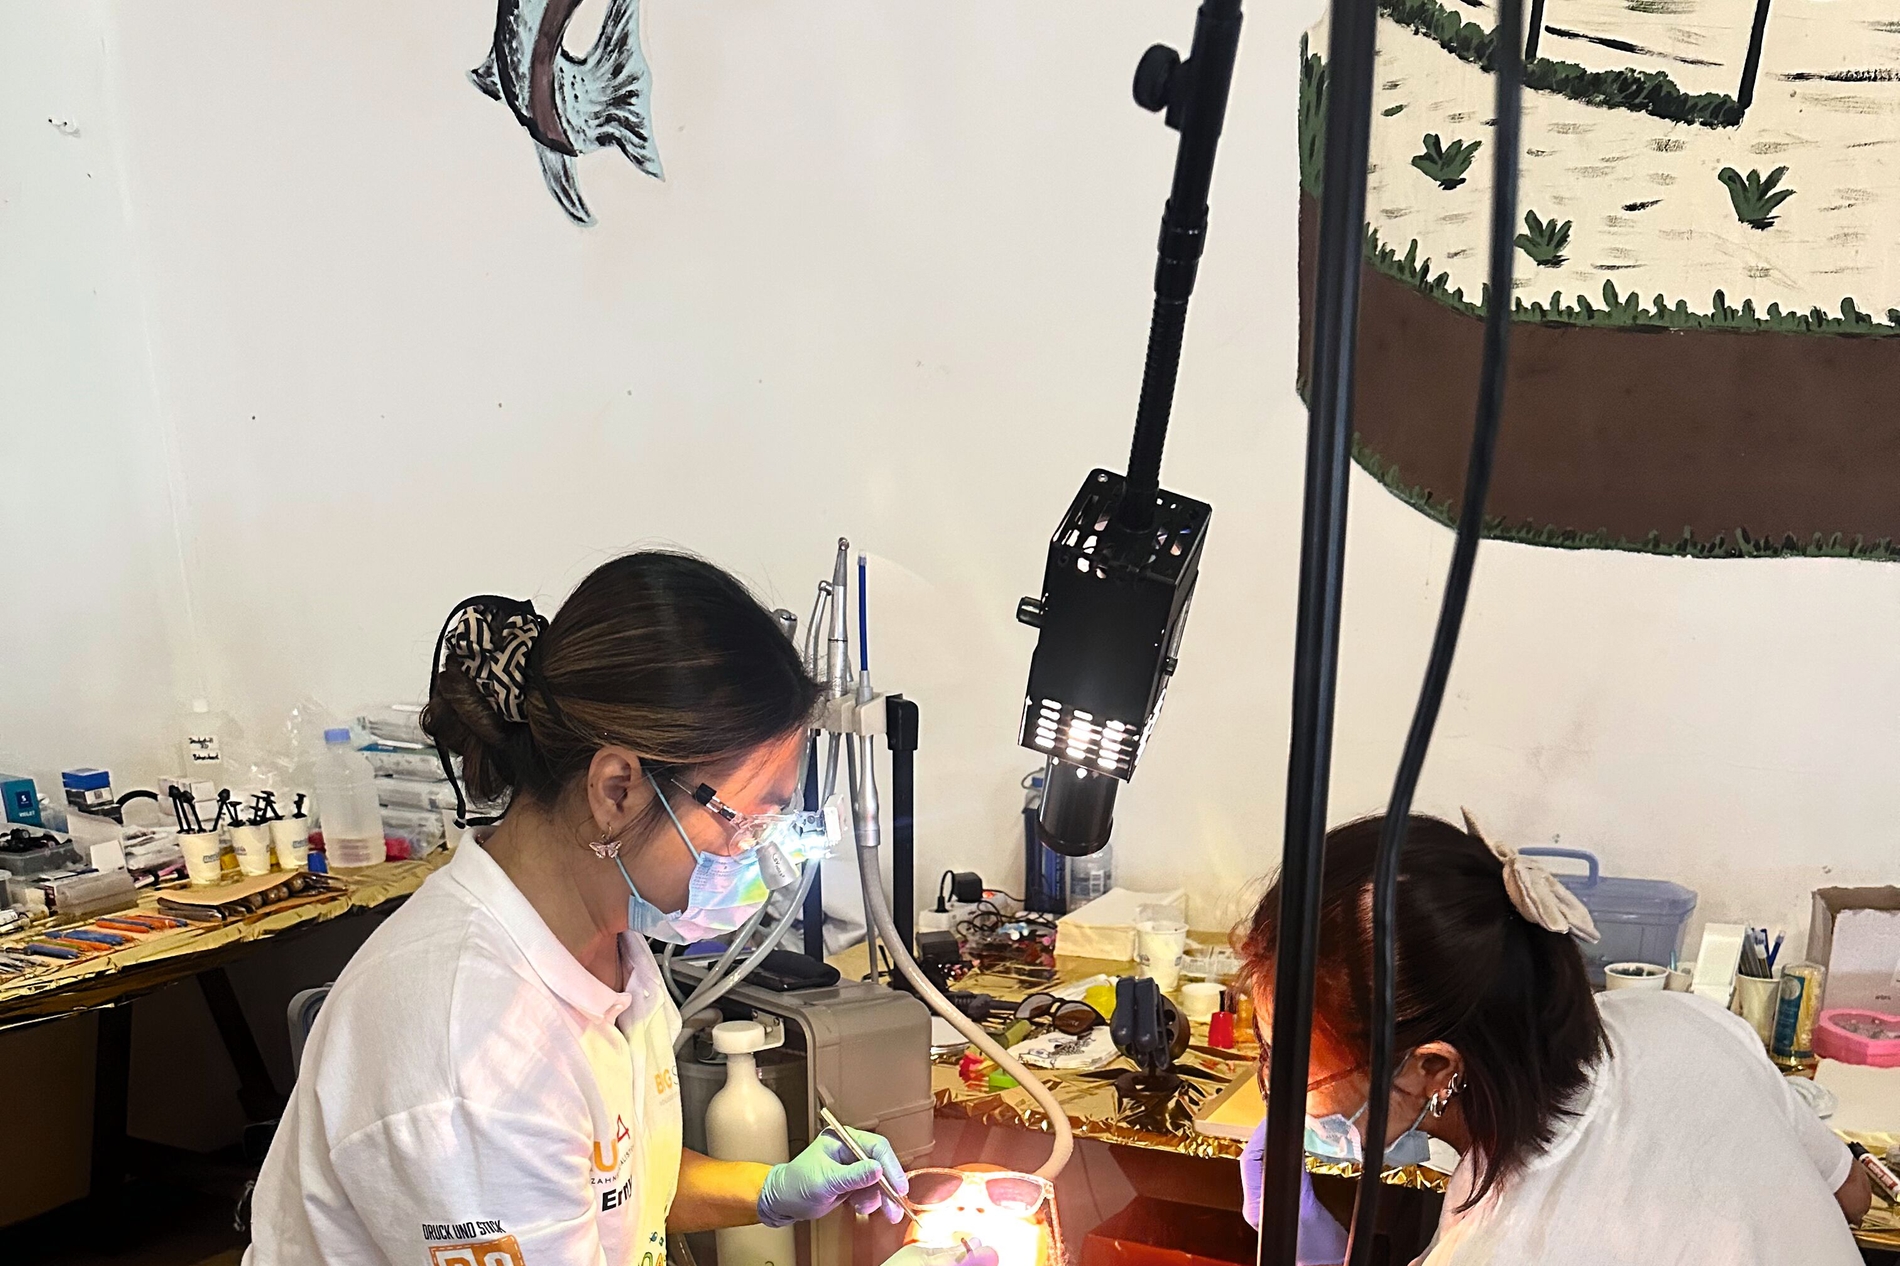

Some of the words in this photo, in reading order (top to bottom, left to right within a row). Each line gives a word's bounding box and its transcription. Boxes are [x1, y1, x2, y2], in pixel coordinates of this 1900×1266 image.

[422, 1223, 452, 1241] DRUCK
[452, 1221, 477, 1240] UND
[476, 1219, 507, 1236] STICK
